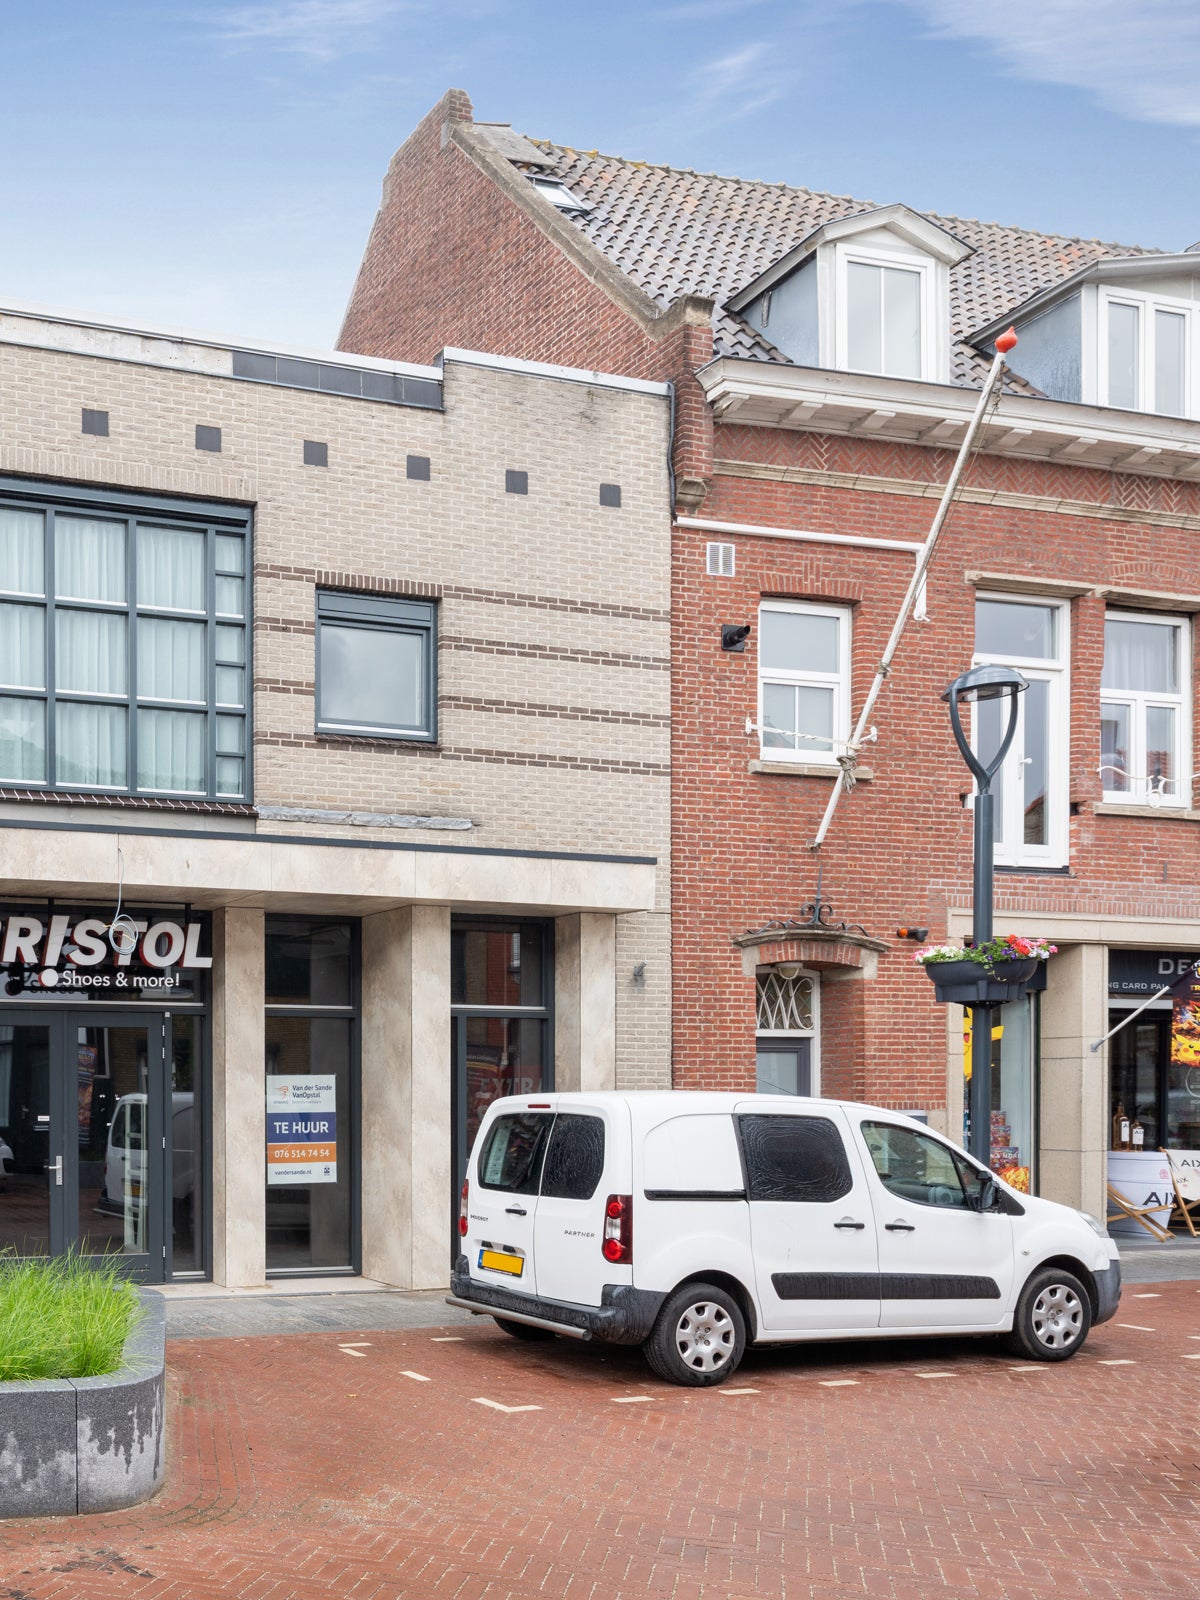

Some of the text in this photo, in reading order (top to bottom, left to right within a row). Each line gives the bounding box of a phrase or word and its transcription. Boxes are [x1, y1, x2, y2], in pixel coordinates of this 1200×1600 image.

[62, 970, 180, 988] Shoes & more!
[1122, 982, 1147, 990] CARD
[273, 1121, 329, 1134] TE HUUR
[274, 1149, 330, 1158] 076 514 74 54
[564, 1229, 595, 1238] PARTNER
